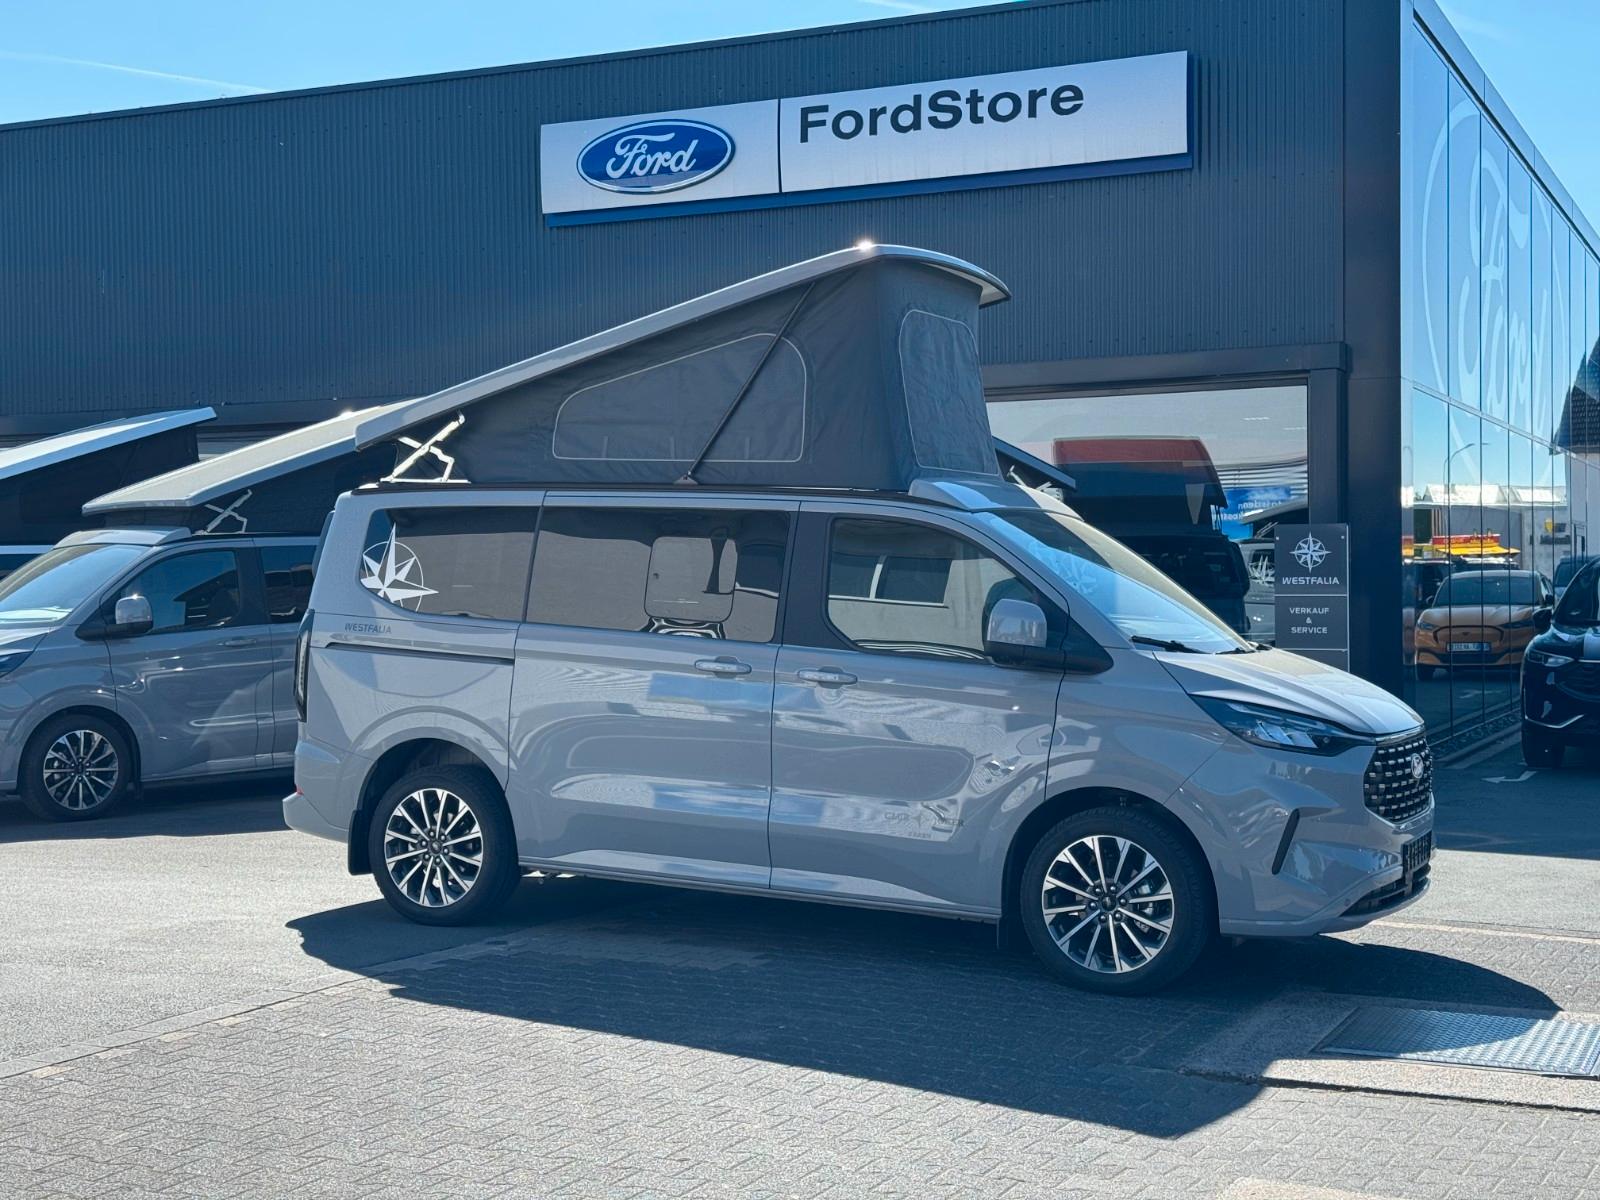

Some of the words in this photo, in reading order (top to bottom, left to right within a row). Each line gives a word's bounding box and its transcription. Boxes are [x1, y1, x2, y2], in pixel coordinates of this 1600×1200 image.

[799, 84, 1084, 144] FordStore
[606, 132, 699, 179] Ford
[1457, 147, 1548, 450] Ford
[1282, 576, 1340, 585] WESTFALIA
[1289, 607, 1330, 615] VERKAUF
[1305, 616, 1312, 624] &
[344, 622, 393, 634] WESTFALIA
[1291, 626, 1328, 634] SERVICE
